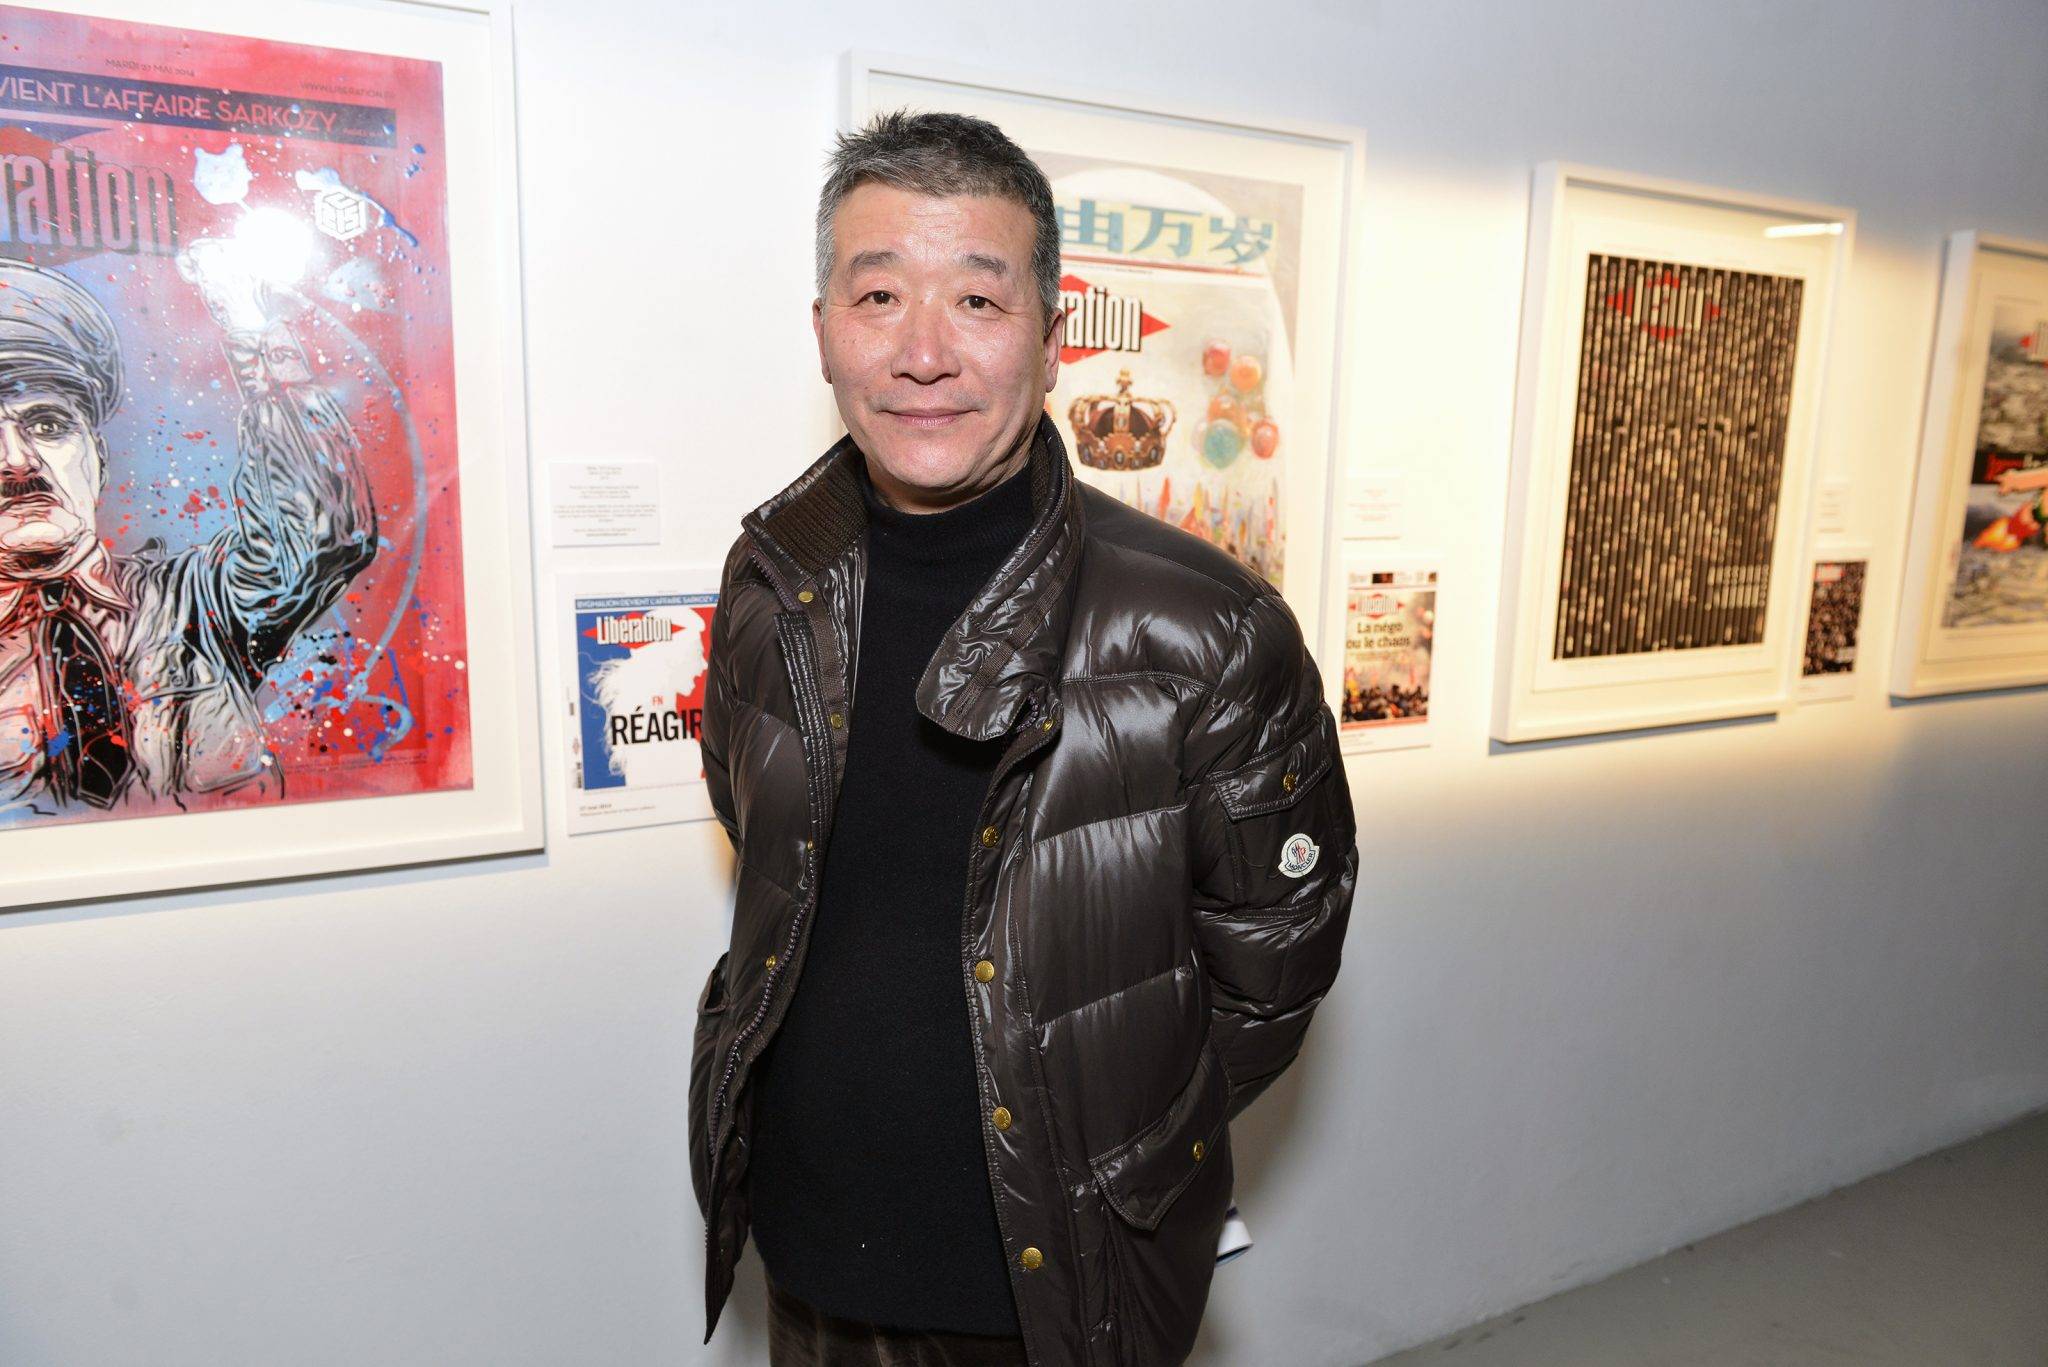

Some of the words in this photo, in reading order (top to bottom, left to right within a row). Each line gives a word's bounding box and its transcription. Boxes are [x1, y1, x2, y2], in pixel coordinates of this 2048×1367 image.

[217, 100, 337, 133] SARKOZY
[597, 616, 671, 645] Libération
[611, 706, 702, 746] RÉAGIR
[1287, 851, 1314, 871] MONCLER
